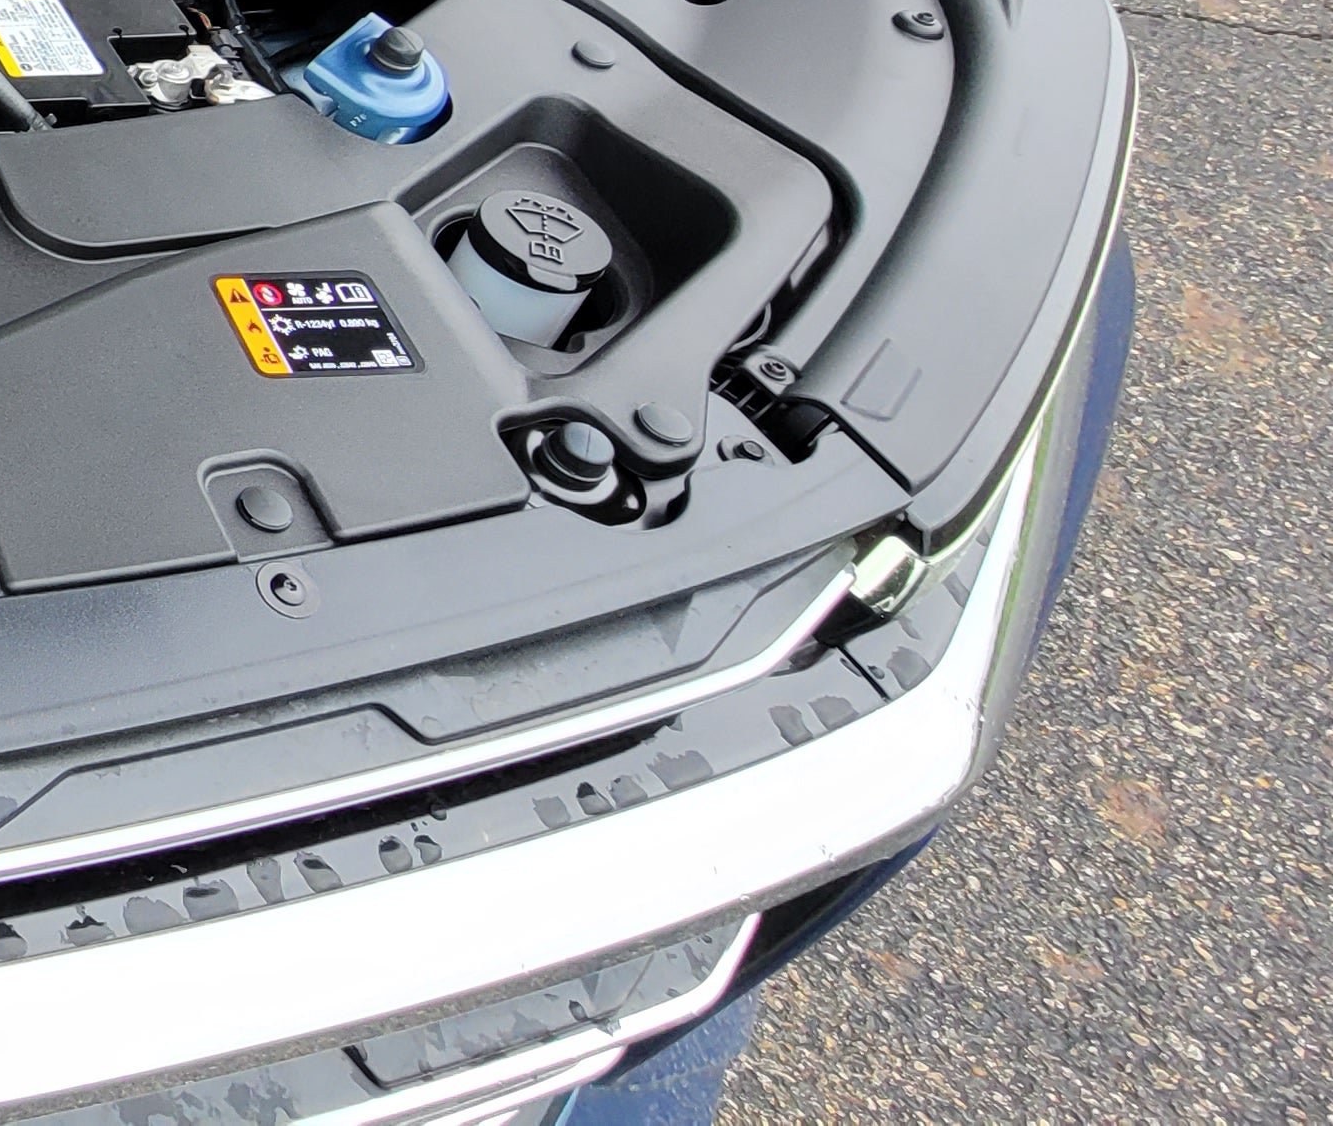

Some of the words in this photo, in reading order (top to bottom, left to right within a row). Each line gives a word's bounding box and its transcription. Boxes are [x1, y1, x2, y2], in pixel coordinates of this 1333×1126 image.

[292, 296, 313, 304] AUTO
[294, 318, 336, 330] R-1234yf
[365, 317, 380, 328] kg
[311, 347, 334, 358] PAG
